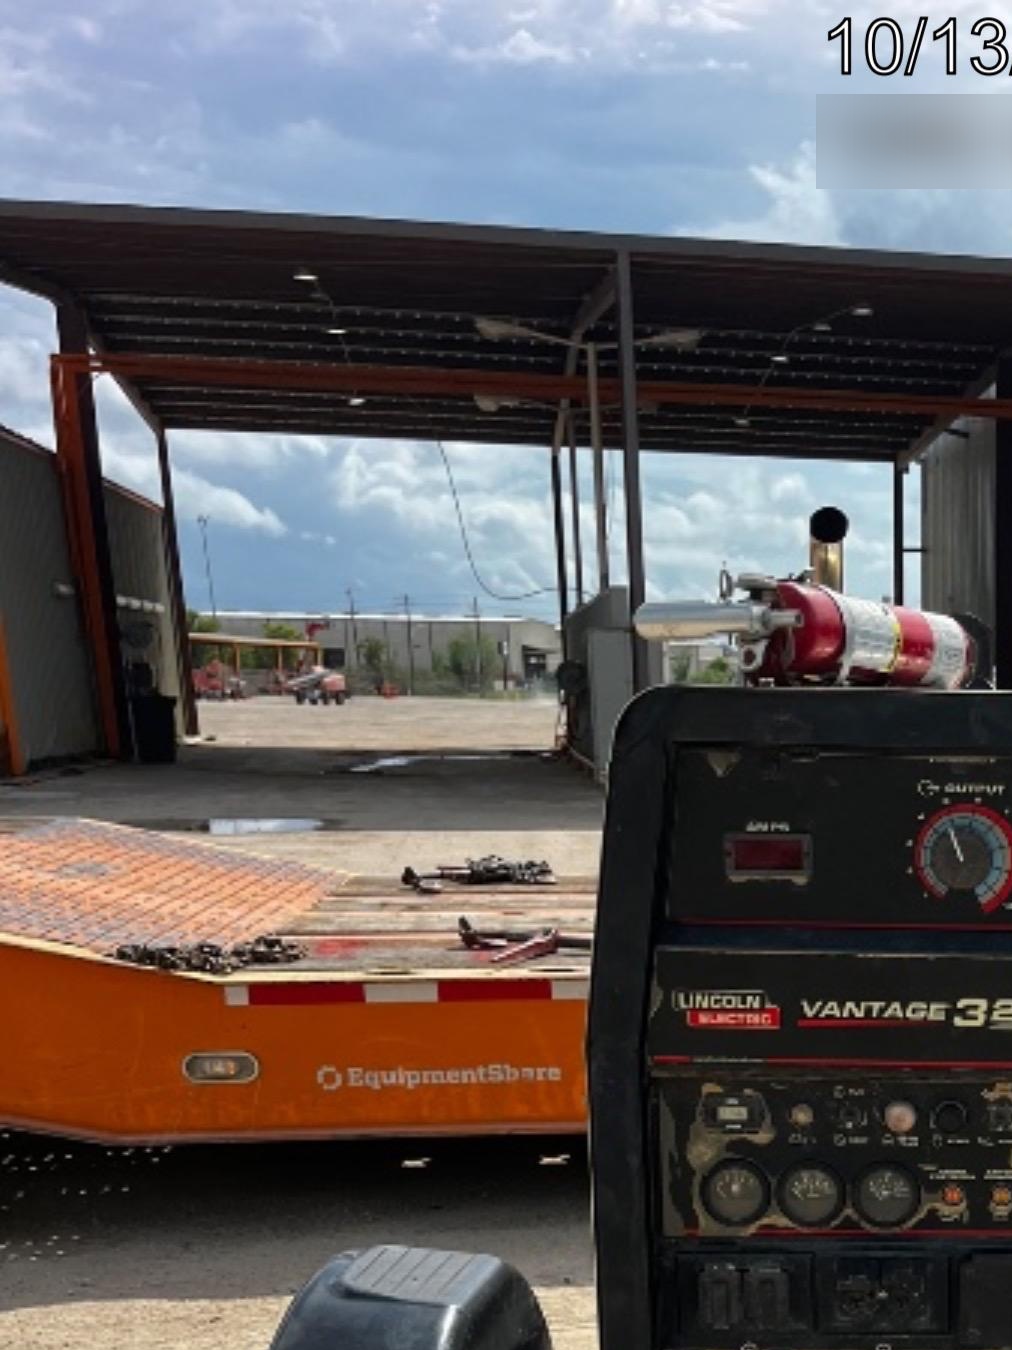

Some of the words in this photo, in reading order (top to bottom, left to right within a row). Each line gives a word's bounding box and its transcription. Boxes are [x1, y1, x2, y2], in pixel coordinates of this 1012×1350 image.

[678, 991, 761, 1009] LINCOLN
[801, 1000, 952, 1021] VANTAGE
[347, 1063, 562, 1089] EquipmentShare
